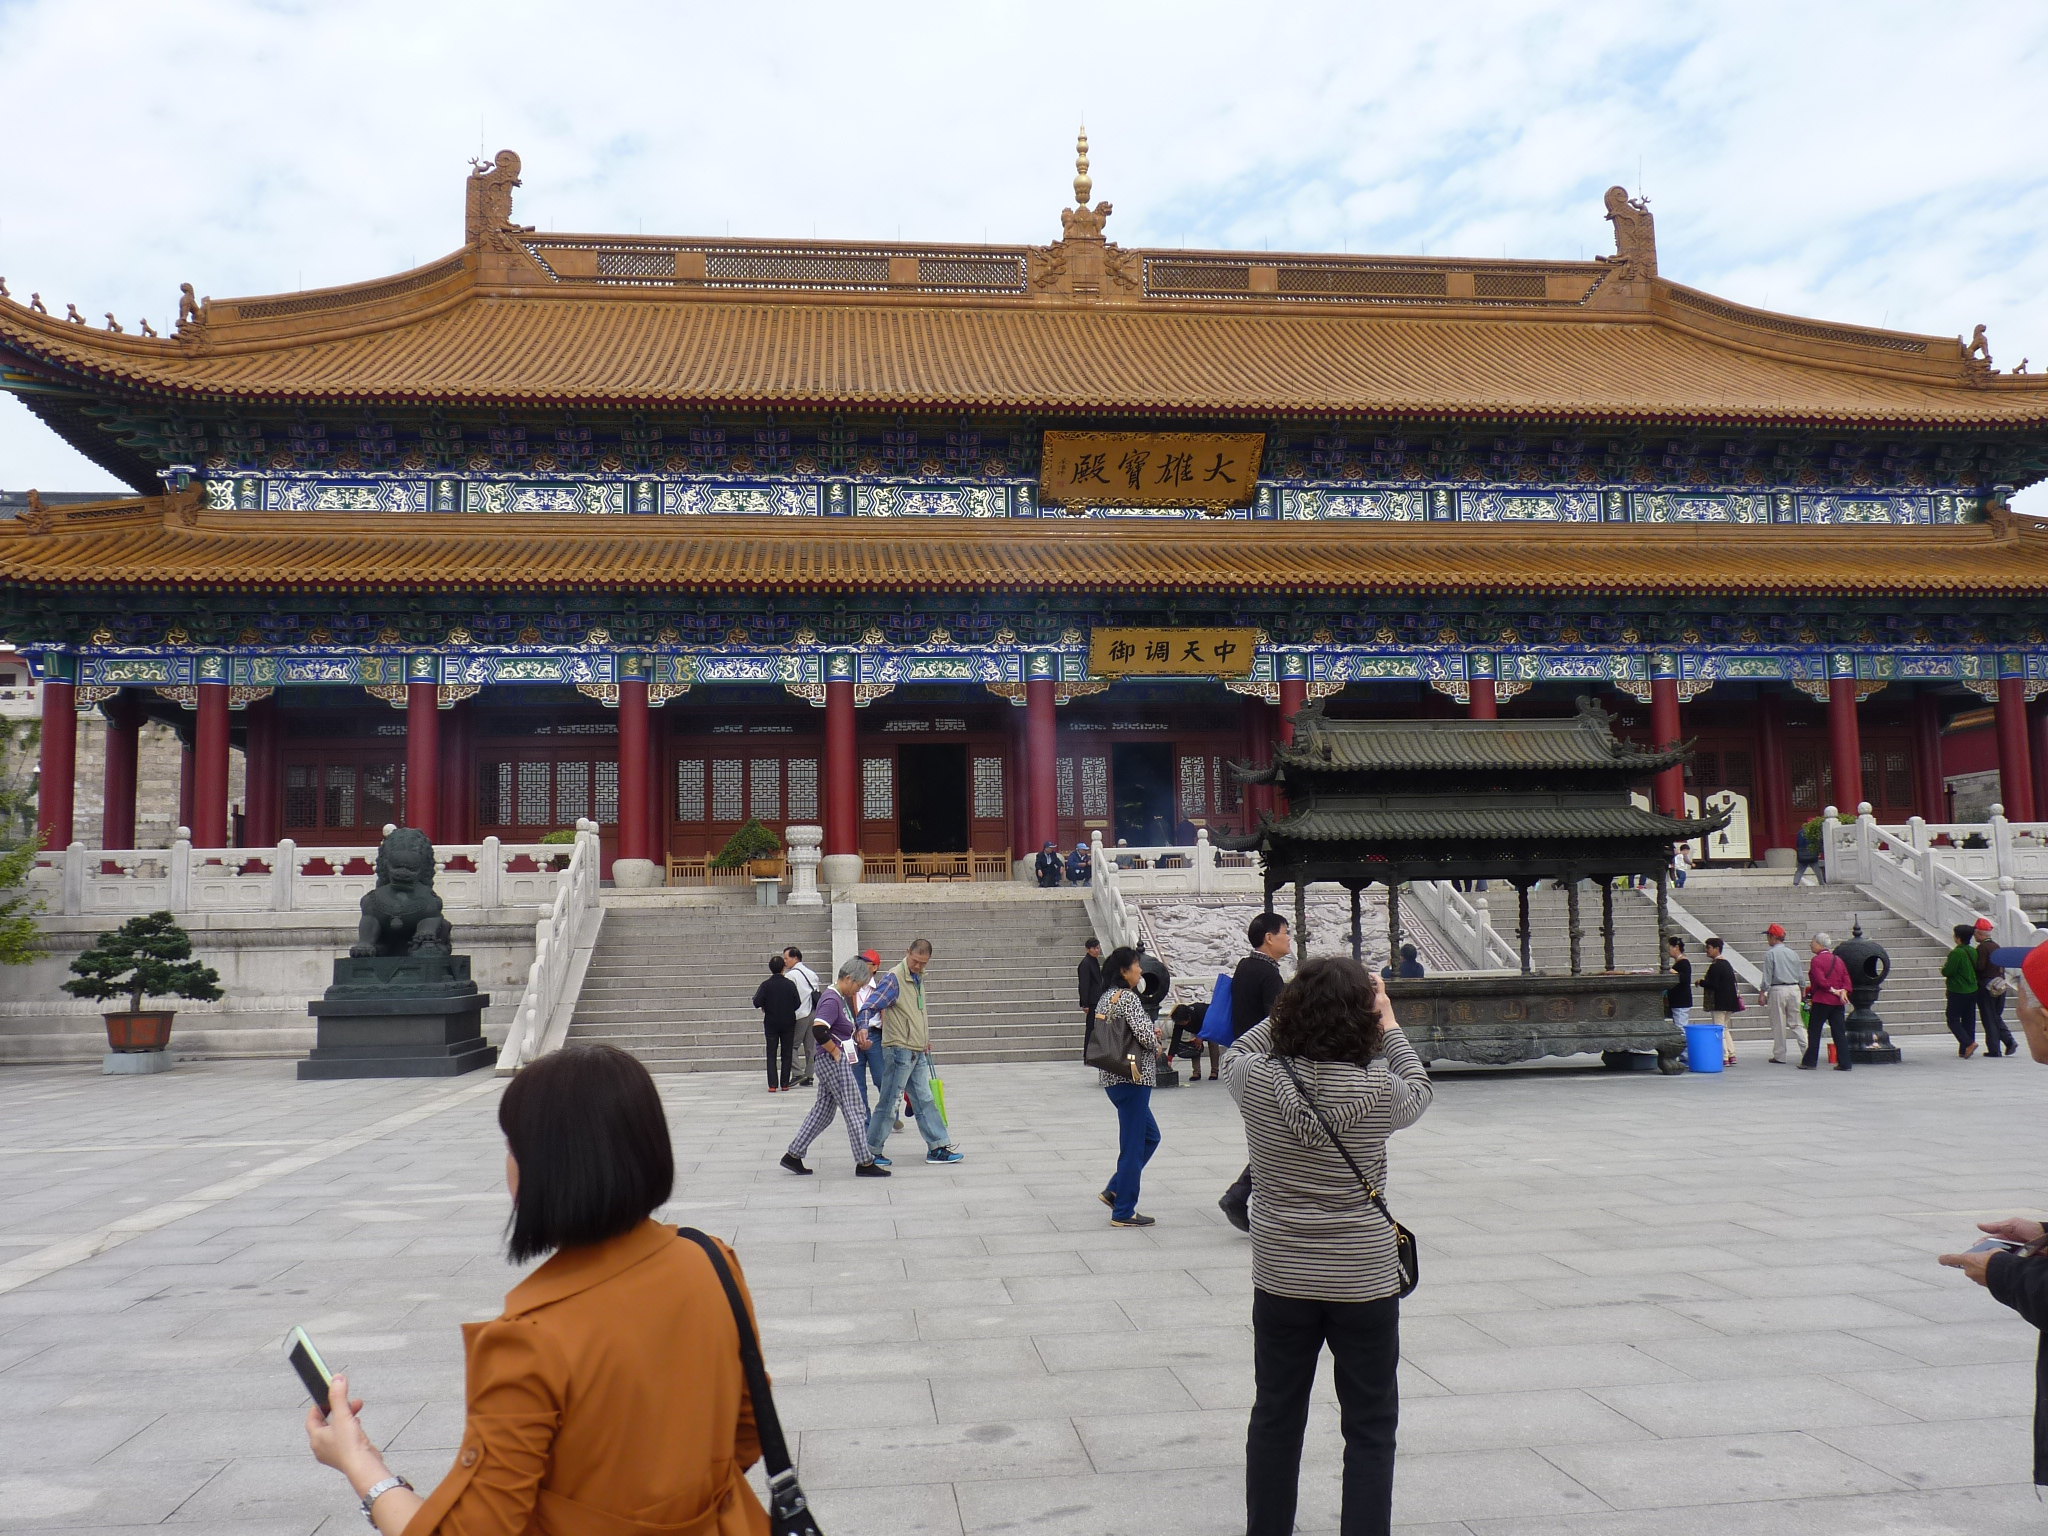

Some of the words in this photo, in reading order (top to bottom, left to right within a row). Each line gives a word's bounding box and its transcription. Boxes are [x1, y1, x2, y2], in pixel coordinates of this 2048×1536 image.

[1070, 449, 1237, 490] 大雄寶殿
[1108, 640, 1237, 664] 中天调御
